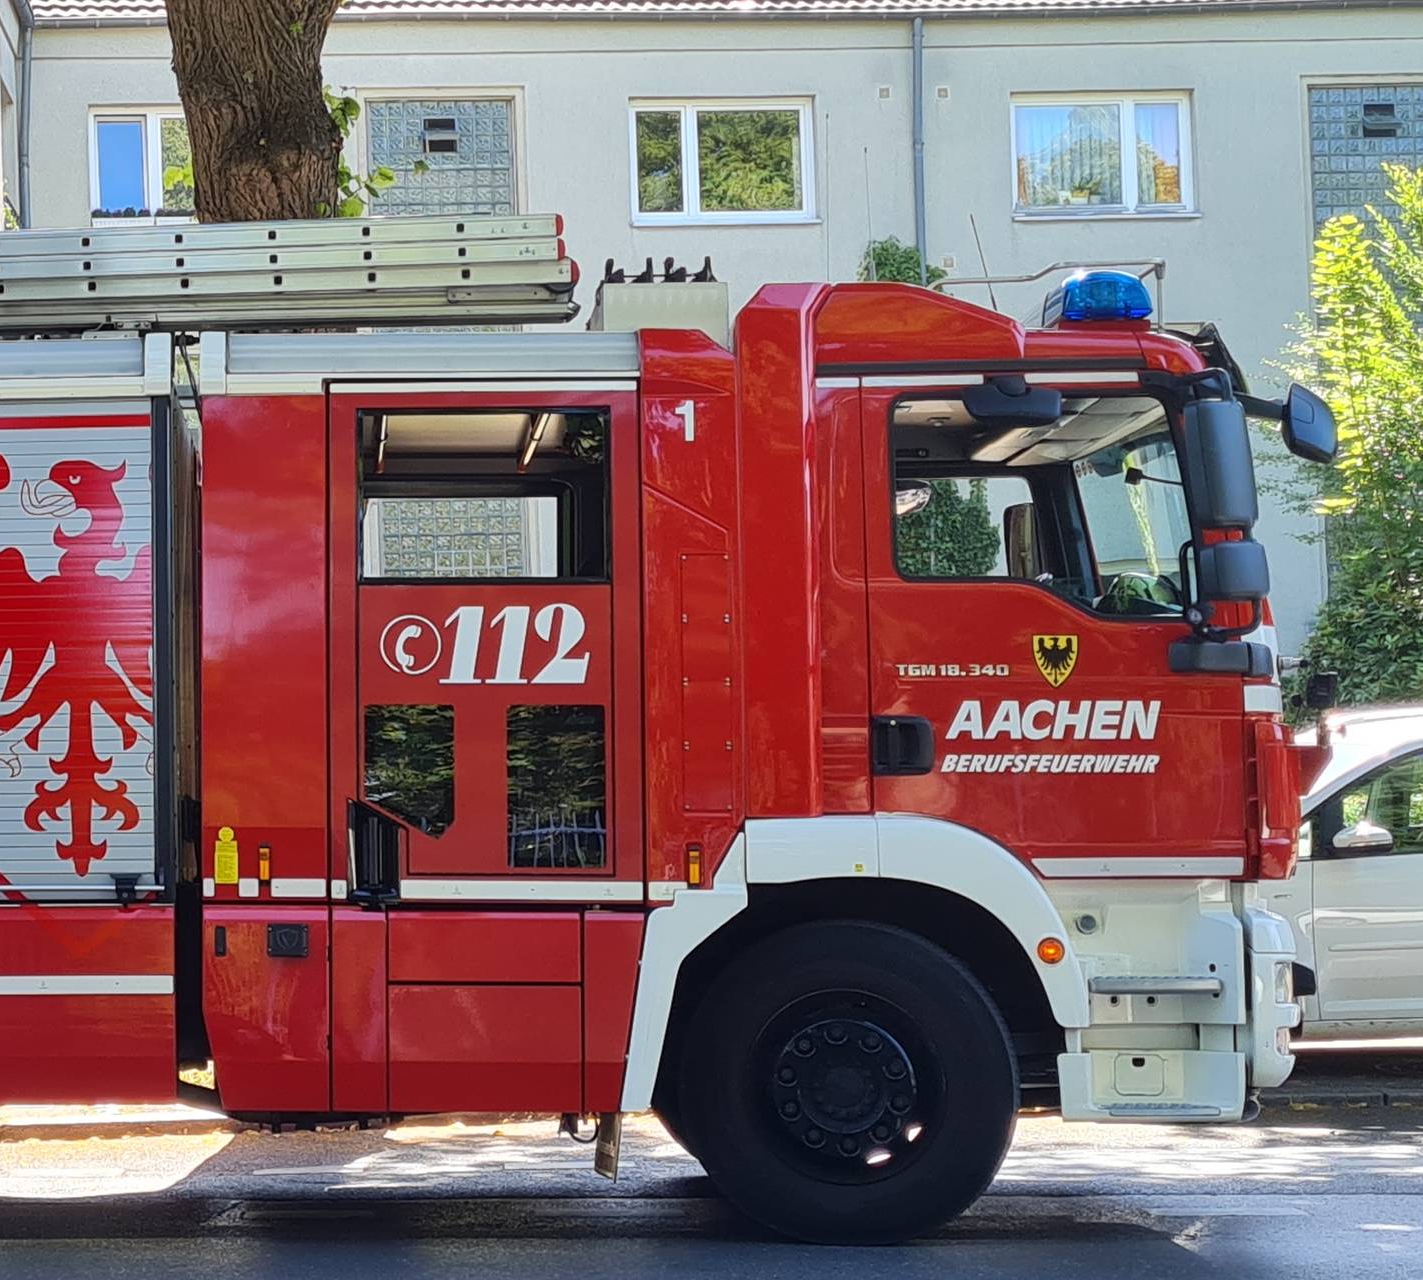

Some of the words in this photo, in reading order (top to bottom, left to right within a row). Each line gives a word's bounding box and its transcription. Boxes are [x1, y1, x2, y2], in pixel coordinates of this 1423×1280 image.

[674, 399, 695, 442] 1
[440, 602, 591, 684] 112
[945, 699, 1162, 740] AACHEN
[940, 754, 1160, 774] BERUFSFEUERWEHR
